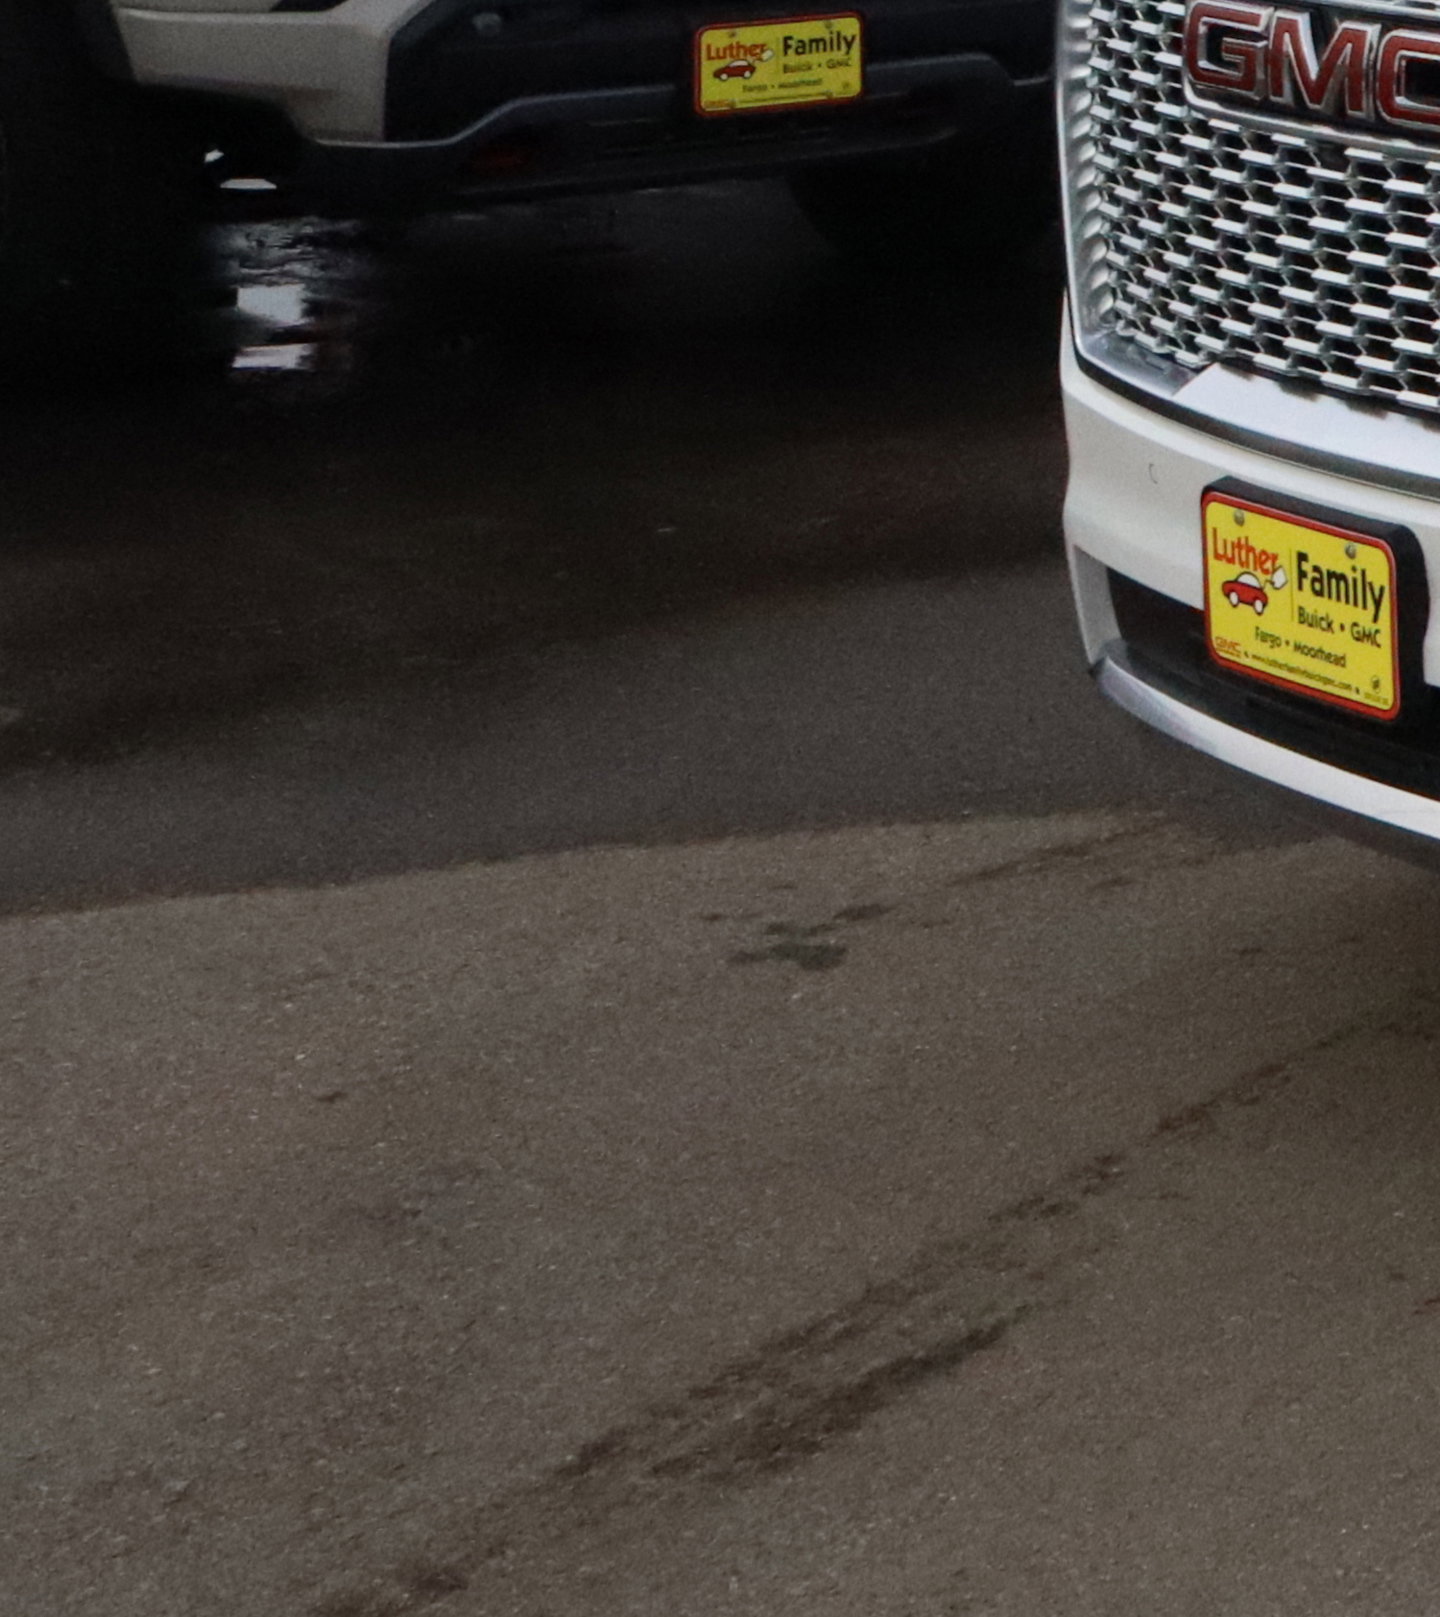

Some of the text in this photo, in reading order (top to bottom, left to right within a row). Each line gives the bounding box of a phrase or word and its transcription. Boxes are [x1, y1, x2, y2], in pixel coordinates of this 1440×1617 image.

[706, 31, 856, 61] Luther Family
[1212, 527, 1386, 624] Luther Family
[1255, 625, 1347, 669] Fargo Moorhead
[1297, 605, 1382, 649] Buick GMC
